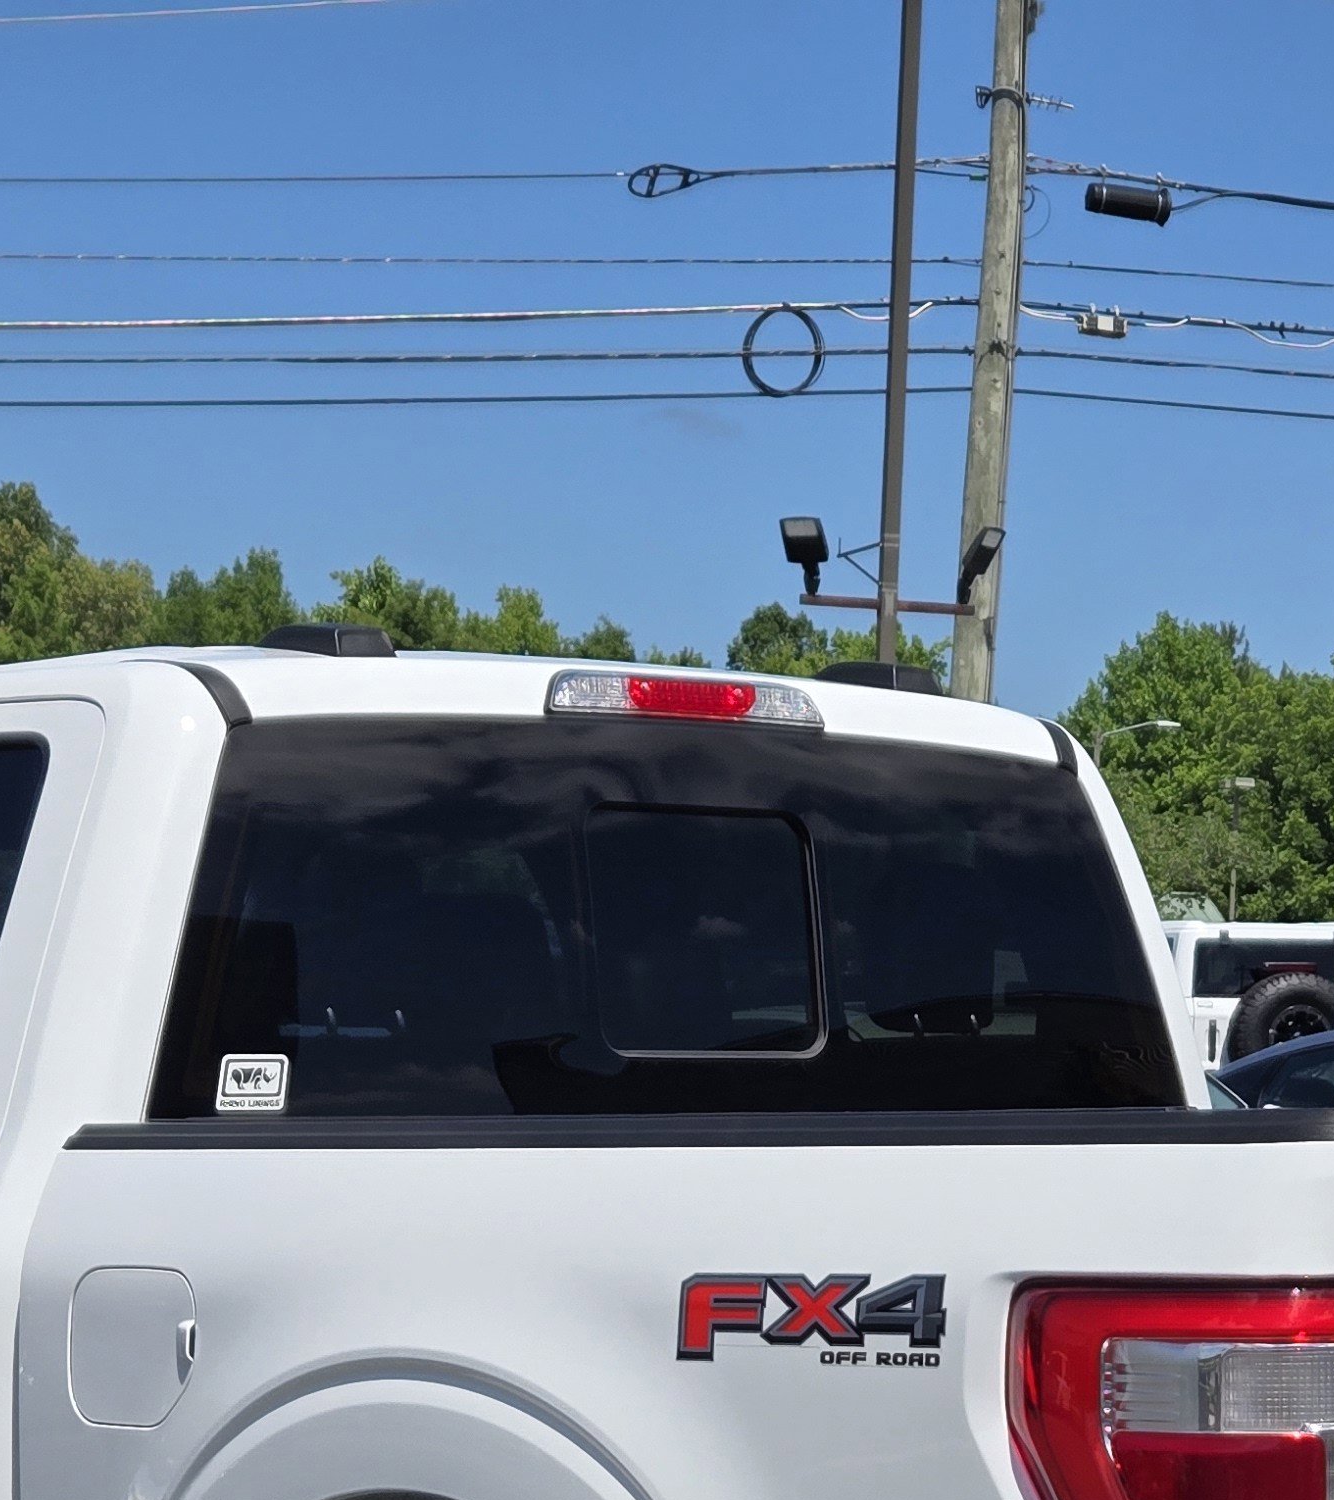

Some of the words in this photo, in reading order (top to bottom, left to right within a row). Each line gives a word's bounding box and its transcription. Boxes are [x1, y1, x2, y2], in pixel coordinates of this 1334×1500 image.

[675, 1272, 947, 1362] FX4
[820, 1351, 867, 1365] OFF
[876, 1352, 941, 1367] ROAD
